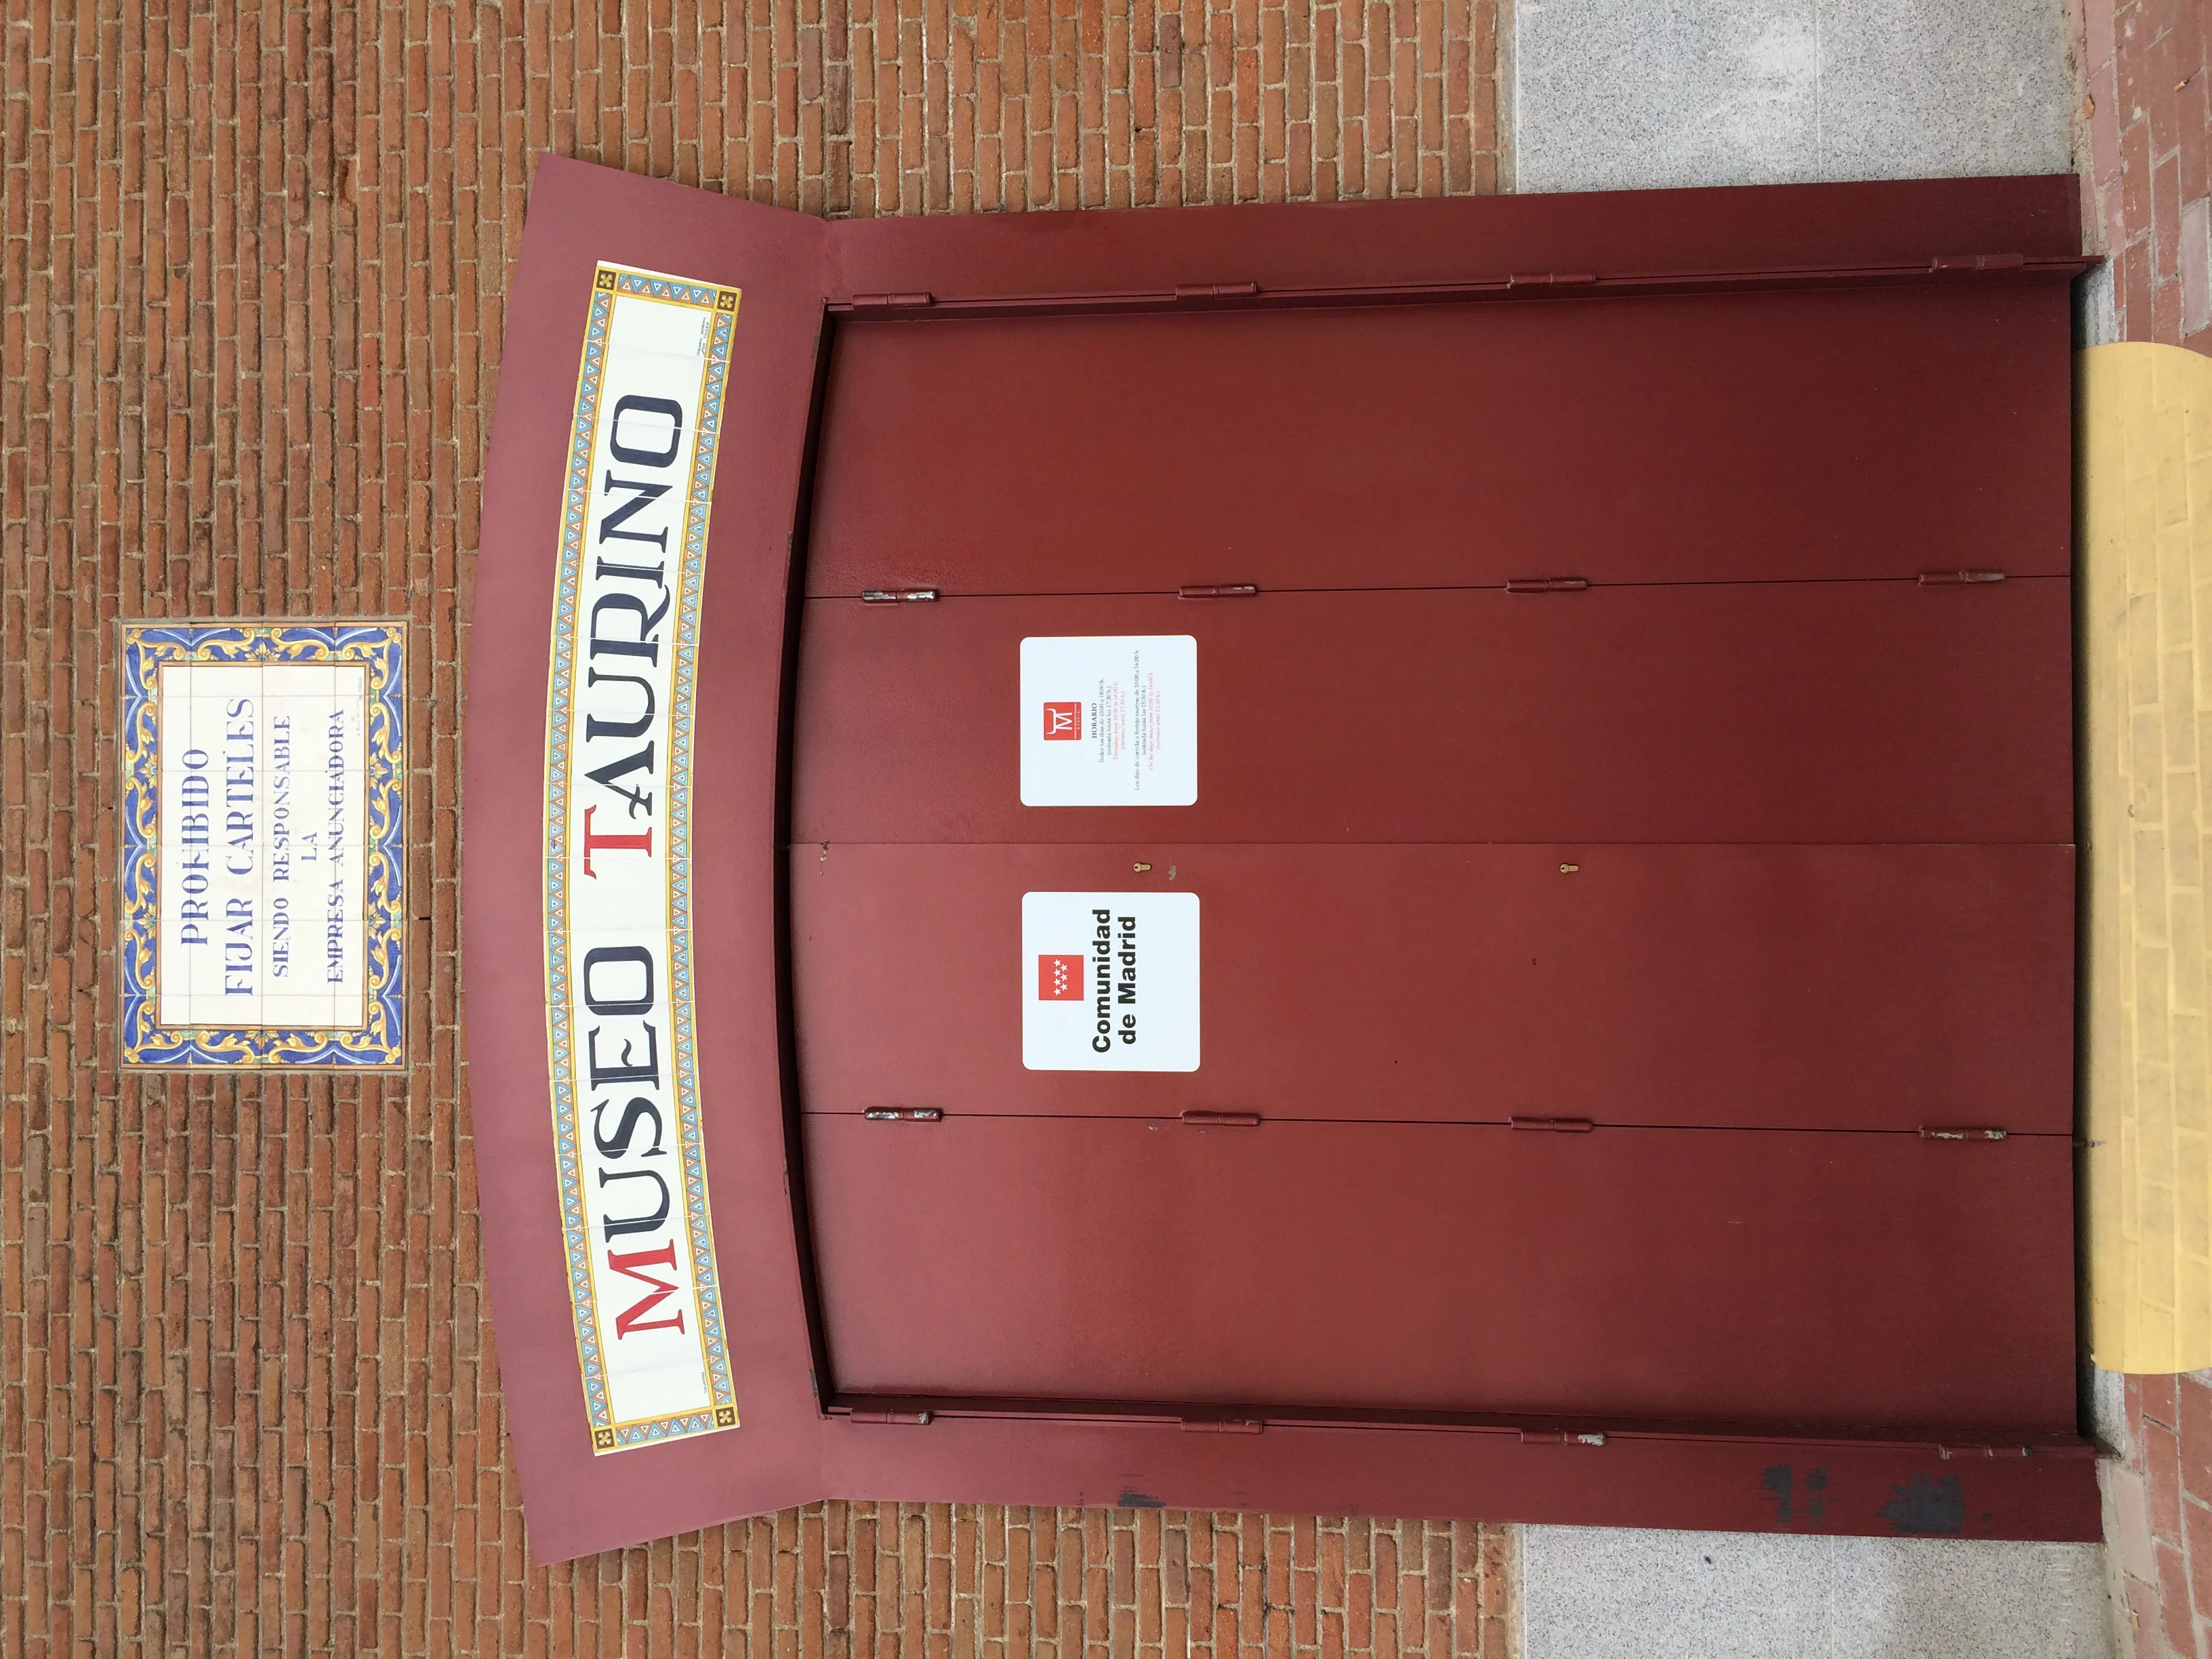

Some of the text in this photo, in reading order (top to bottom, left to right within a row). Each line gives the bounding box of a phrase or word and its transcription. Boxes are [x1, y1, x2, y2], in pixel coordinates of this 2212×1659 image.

[181, 749, 209, 945] PROHIBIDO
[225, 698, 254, 996] FIJAR CARTELES
[273, 716, 290, 977] SIENDO RESPONSABLE
[302, 832, 317, 861] LA
[327, 710, 344, 984] EMPRESA ANUNCIADORA
[583, 394, 685, 1340] MUSEO TAURINO
[1092, 909, 1111, 1053] Comunidad
[1118, 916, 1136, 1044] de Madrid
